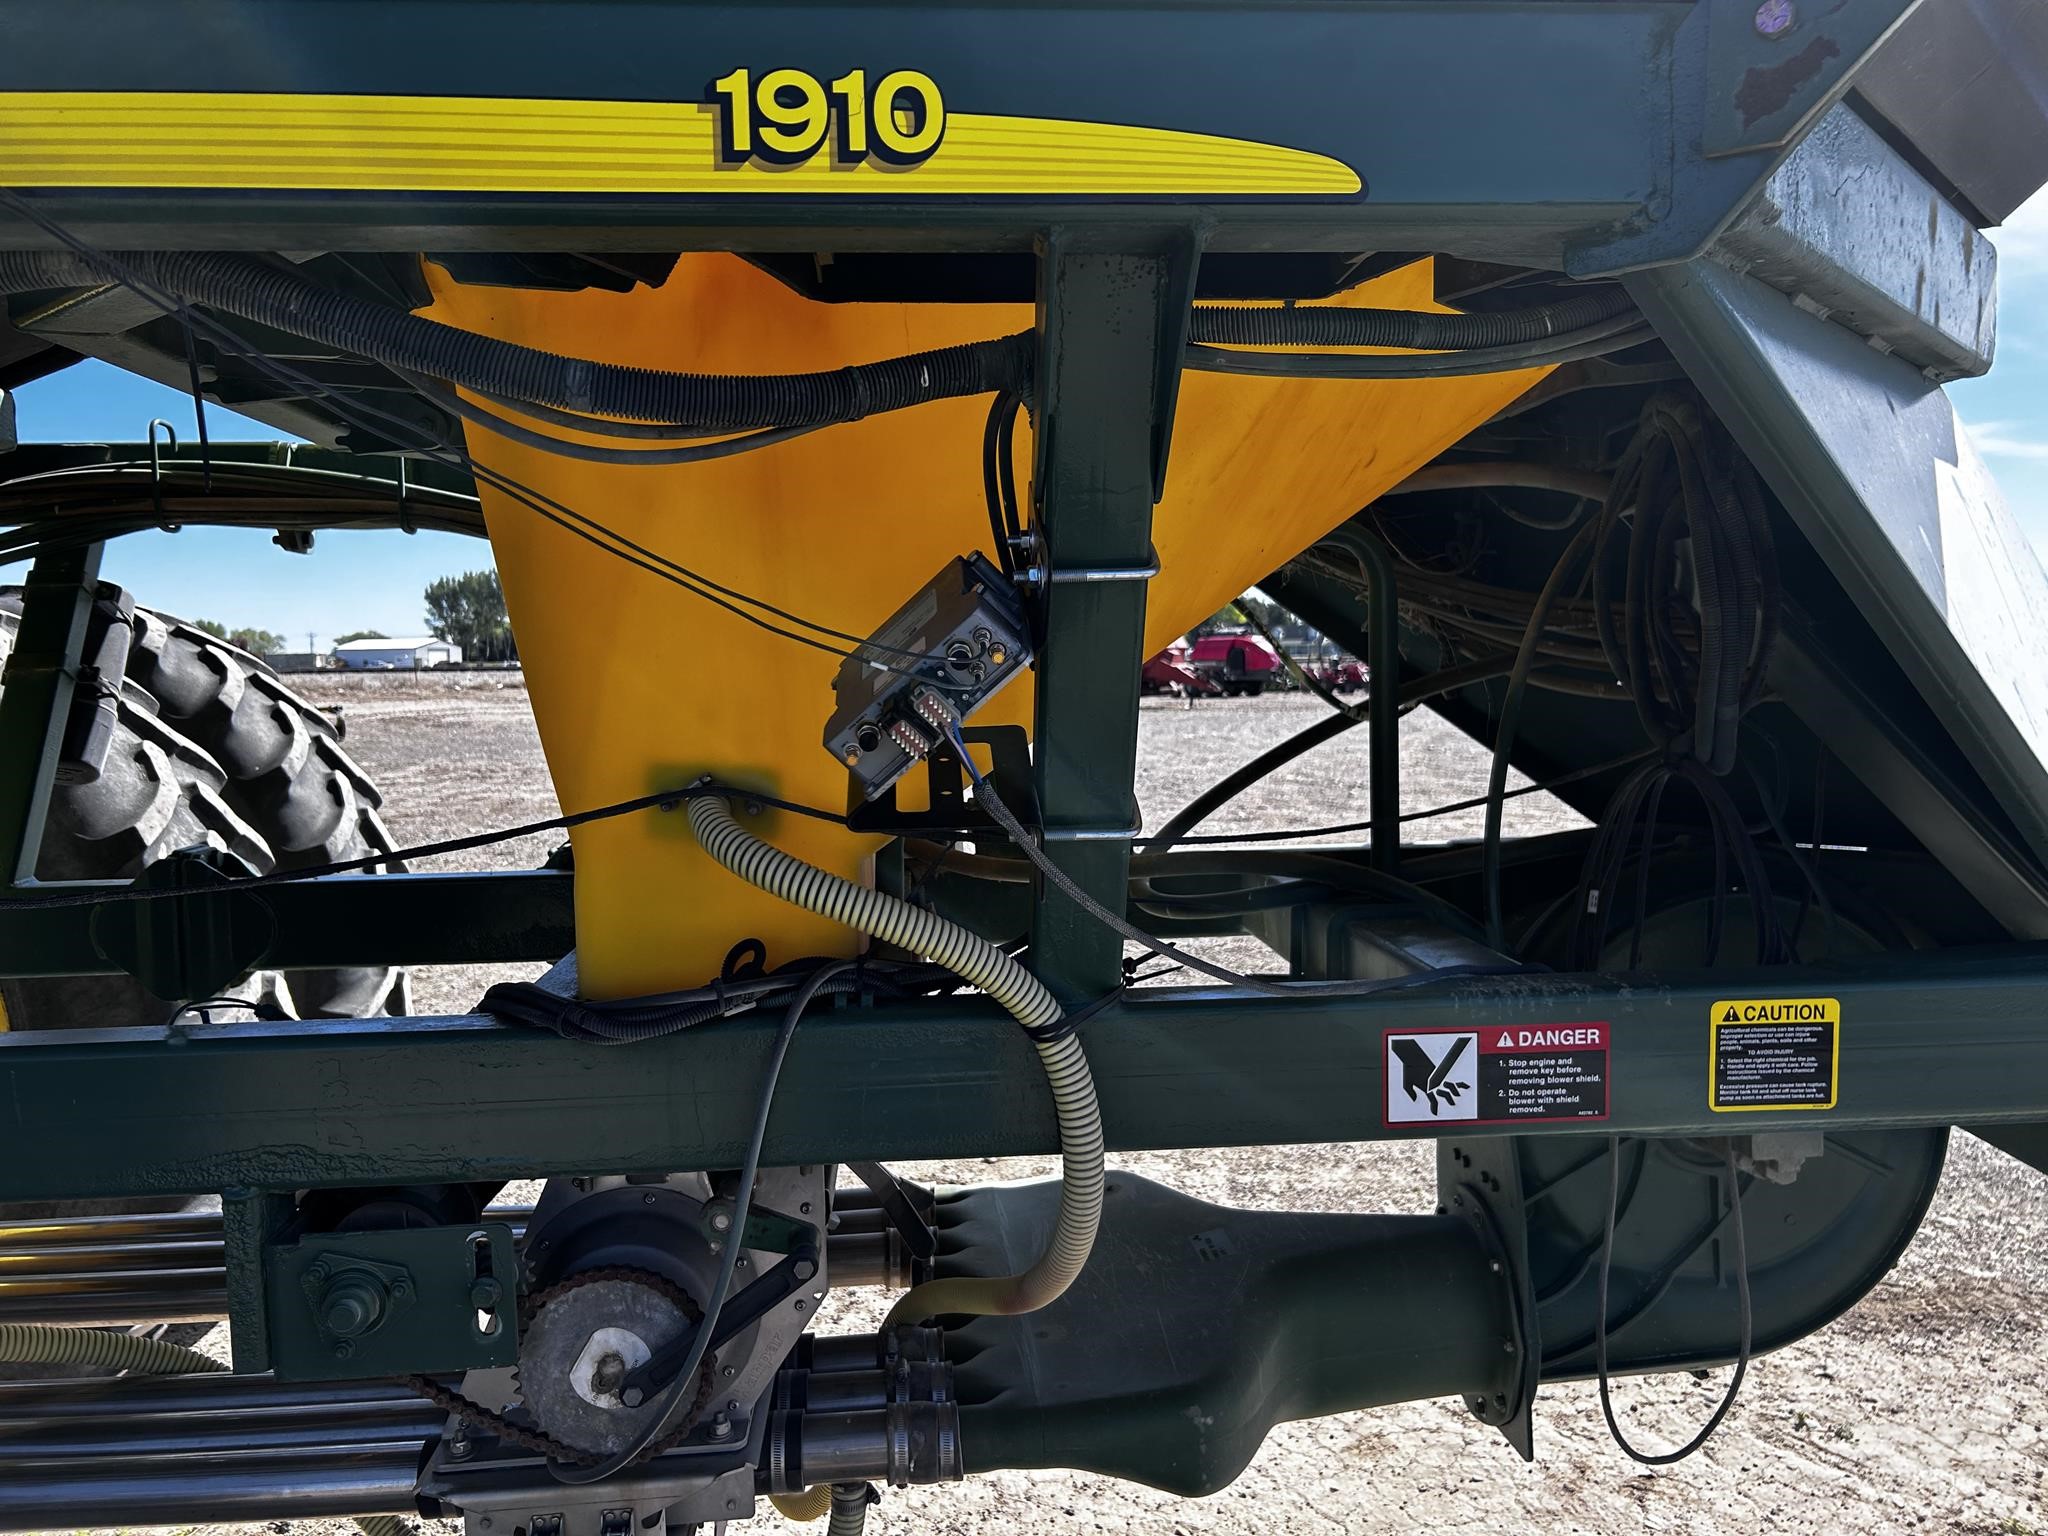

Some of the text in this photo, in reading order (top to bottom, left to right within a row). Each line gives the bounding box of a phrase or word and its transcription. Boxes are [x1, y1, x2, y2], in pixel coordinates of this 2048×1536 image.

[712, 67, 946, 157] 1910
[1744, 1004, 1825, 1021] CAUTION
[1519, 1029, 1600, 1047] DANGER
[1508, 1059, 1526, 1068] Stop
[1529, 1058, 1556, 1067] engine
[1558, 1057, 1572, 1065] and
[1540, 1067, 1554, 1075] key
[1556, 1065, 1582, 1073] before
[1509, 1074, 1601, 1086] removing blower shield.
[1498, 1089, 1506, 1097] 2.
[1536, 1088, 1567, 1096] operate
[1508, 1095, 1580, 1105] blower with shield
[1510, 1105, 1546, 1113] removed.
